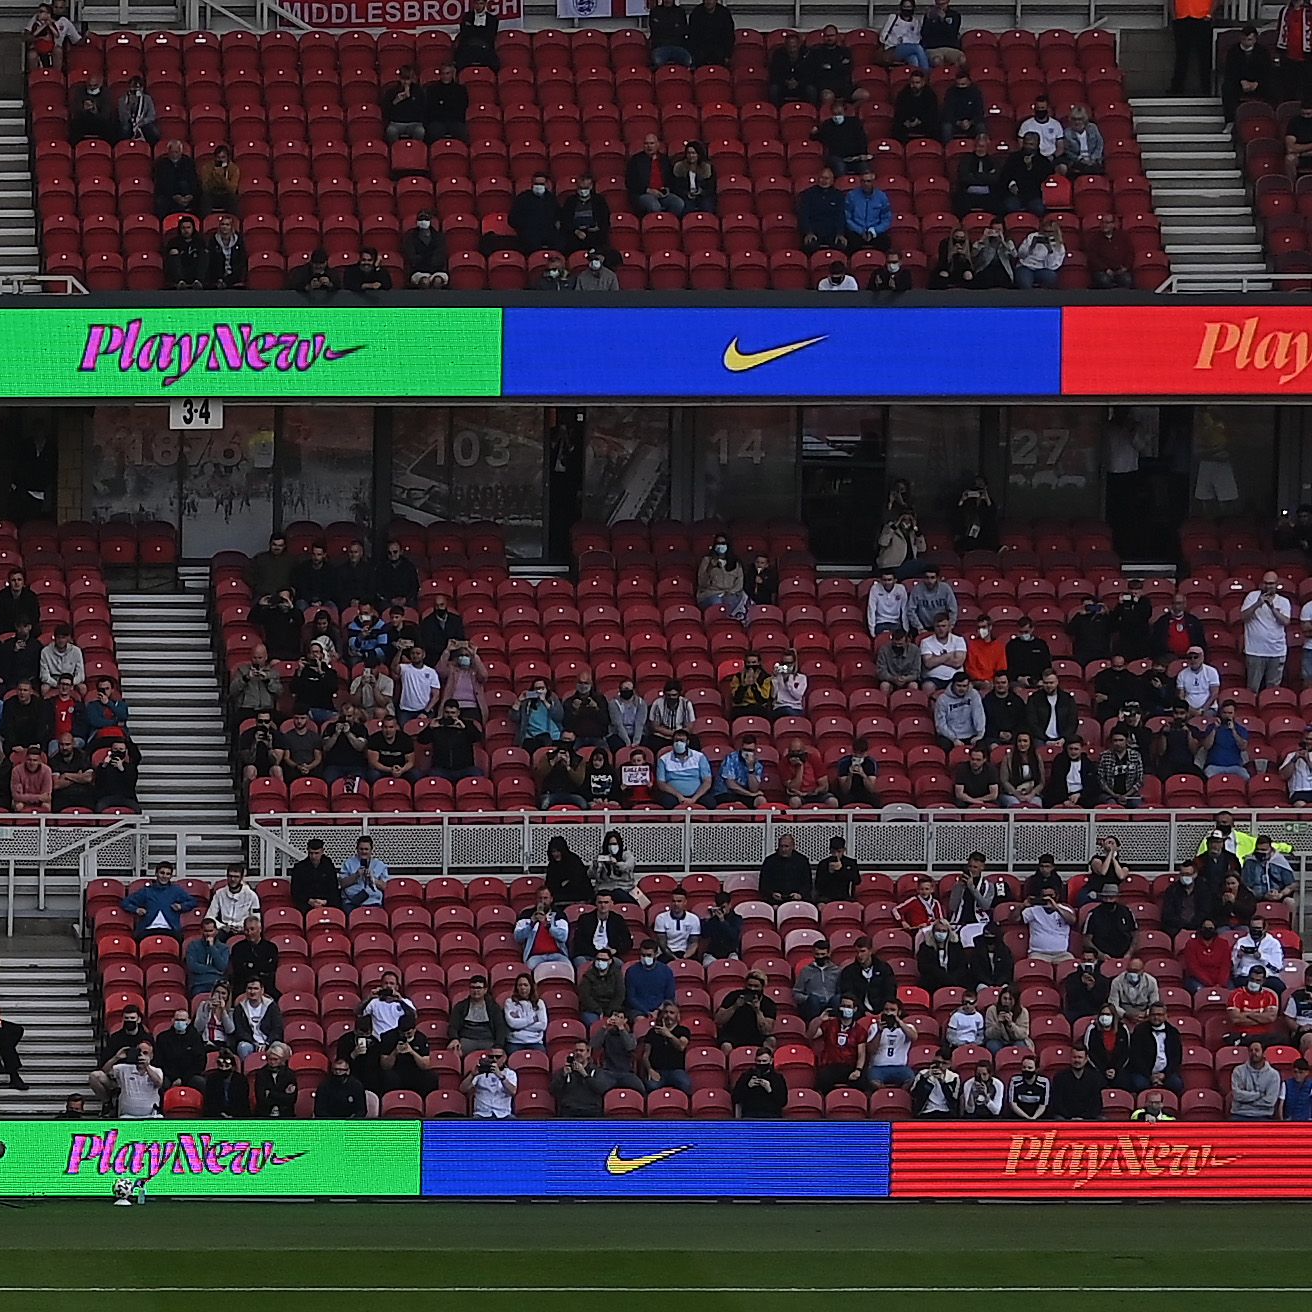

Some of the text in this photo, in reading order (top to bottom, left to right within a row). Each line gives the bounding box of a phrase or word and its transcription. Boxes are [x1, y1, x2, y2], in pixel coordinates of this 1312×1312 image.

[77, 318, 327, 387] PlayNew
[431, 429, 510, 467] 103
[710, 428, 767, 465] 14
[1011, 428, 1070, 465] 27
[63, 1128, 274, 1188] PlayNew
[1002, 1130, 1213, 1190] PlayNew
